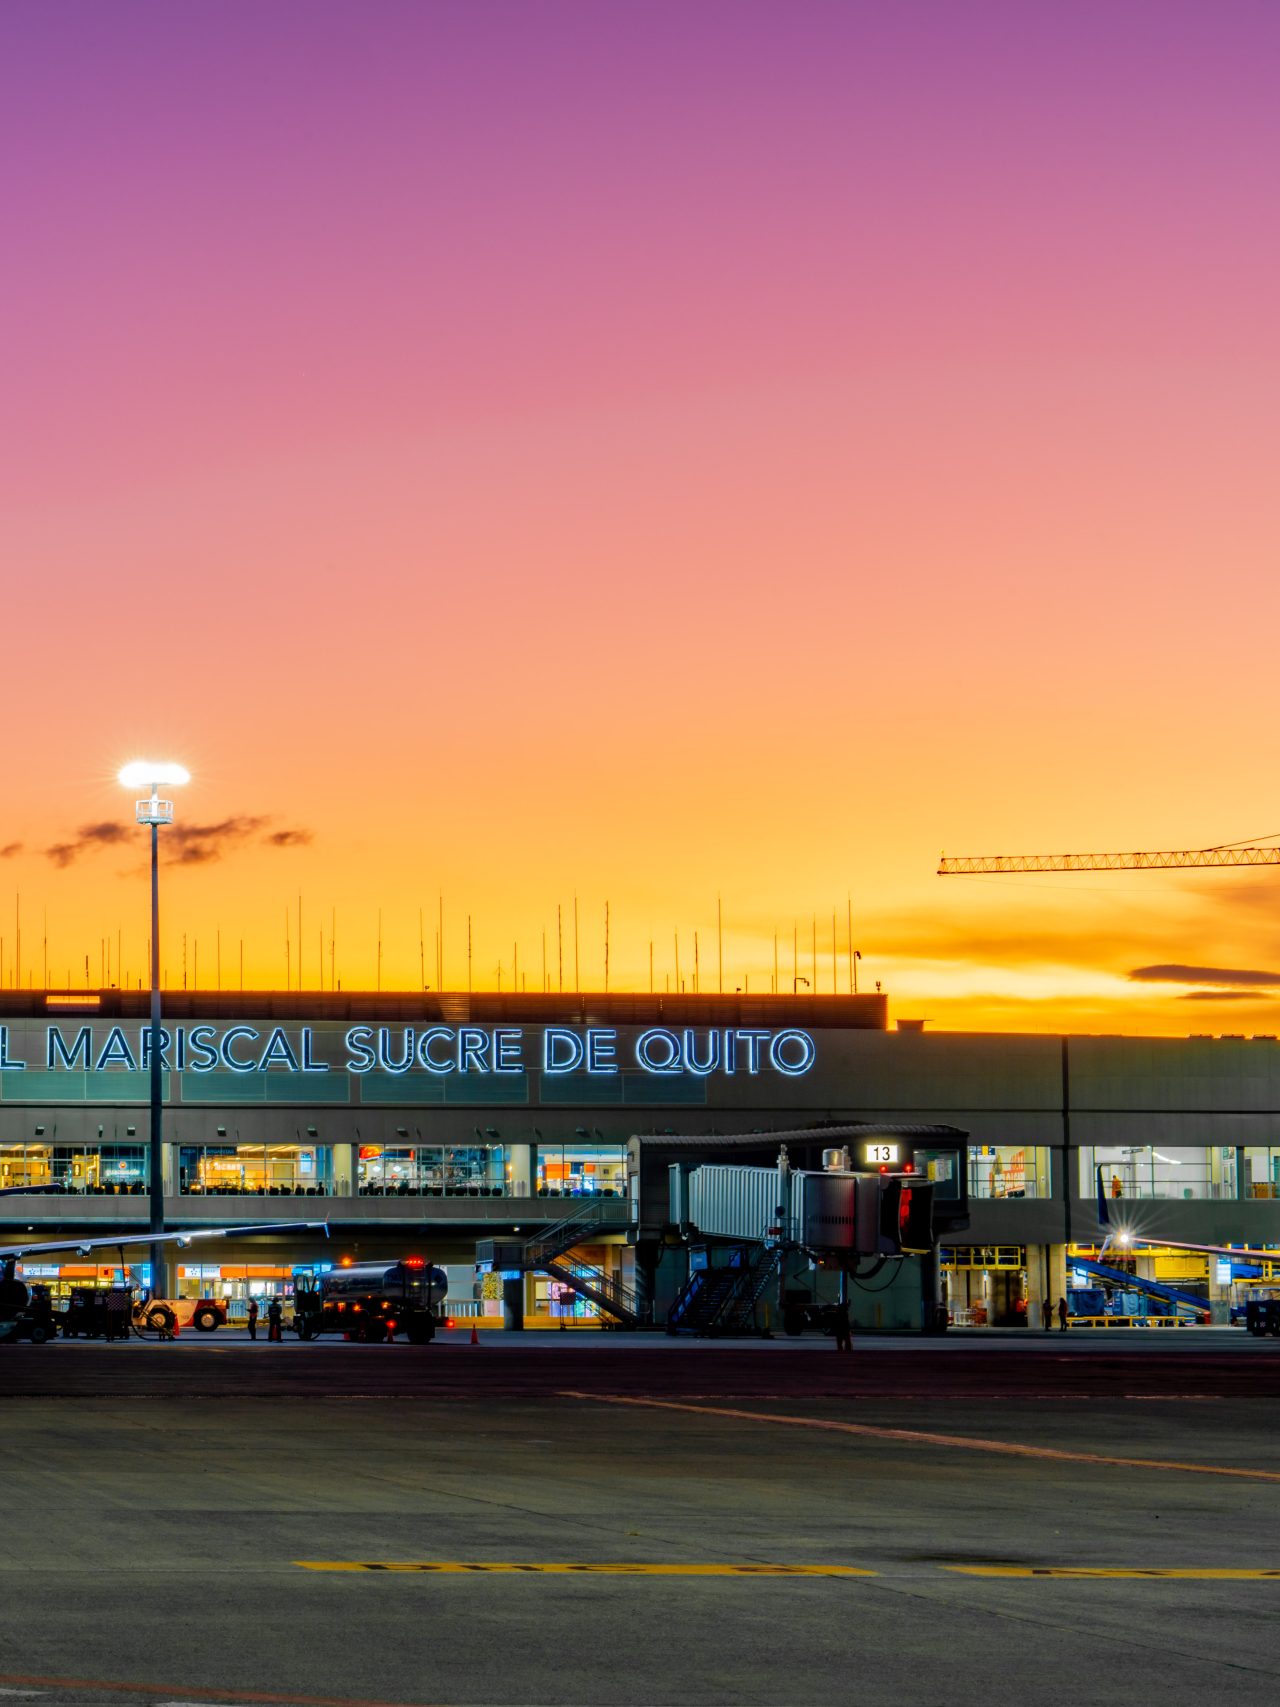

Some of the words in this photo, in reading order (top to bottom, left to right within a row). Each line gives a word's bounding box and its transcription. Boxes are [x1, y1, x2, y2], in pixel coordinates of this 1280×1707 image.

[46, 1025, 329, 1073] MARISCAL
[344, 1025, 523, 1075] SUCRE
[543, 1028, 617, 1076] DE
[635, 1028, 815, 1077] QUITO
[873, 1146, 890, 1161] 13
